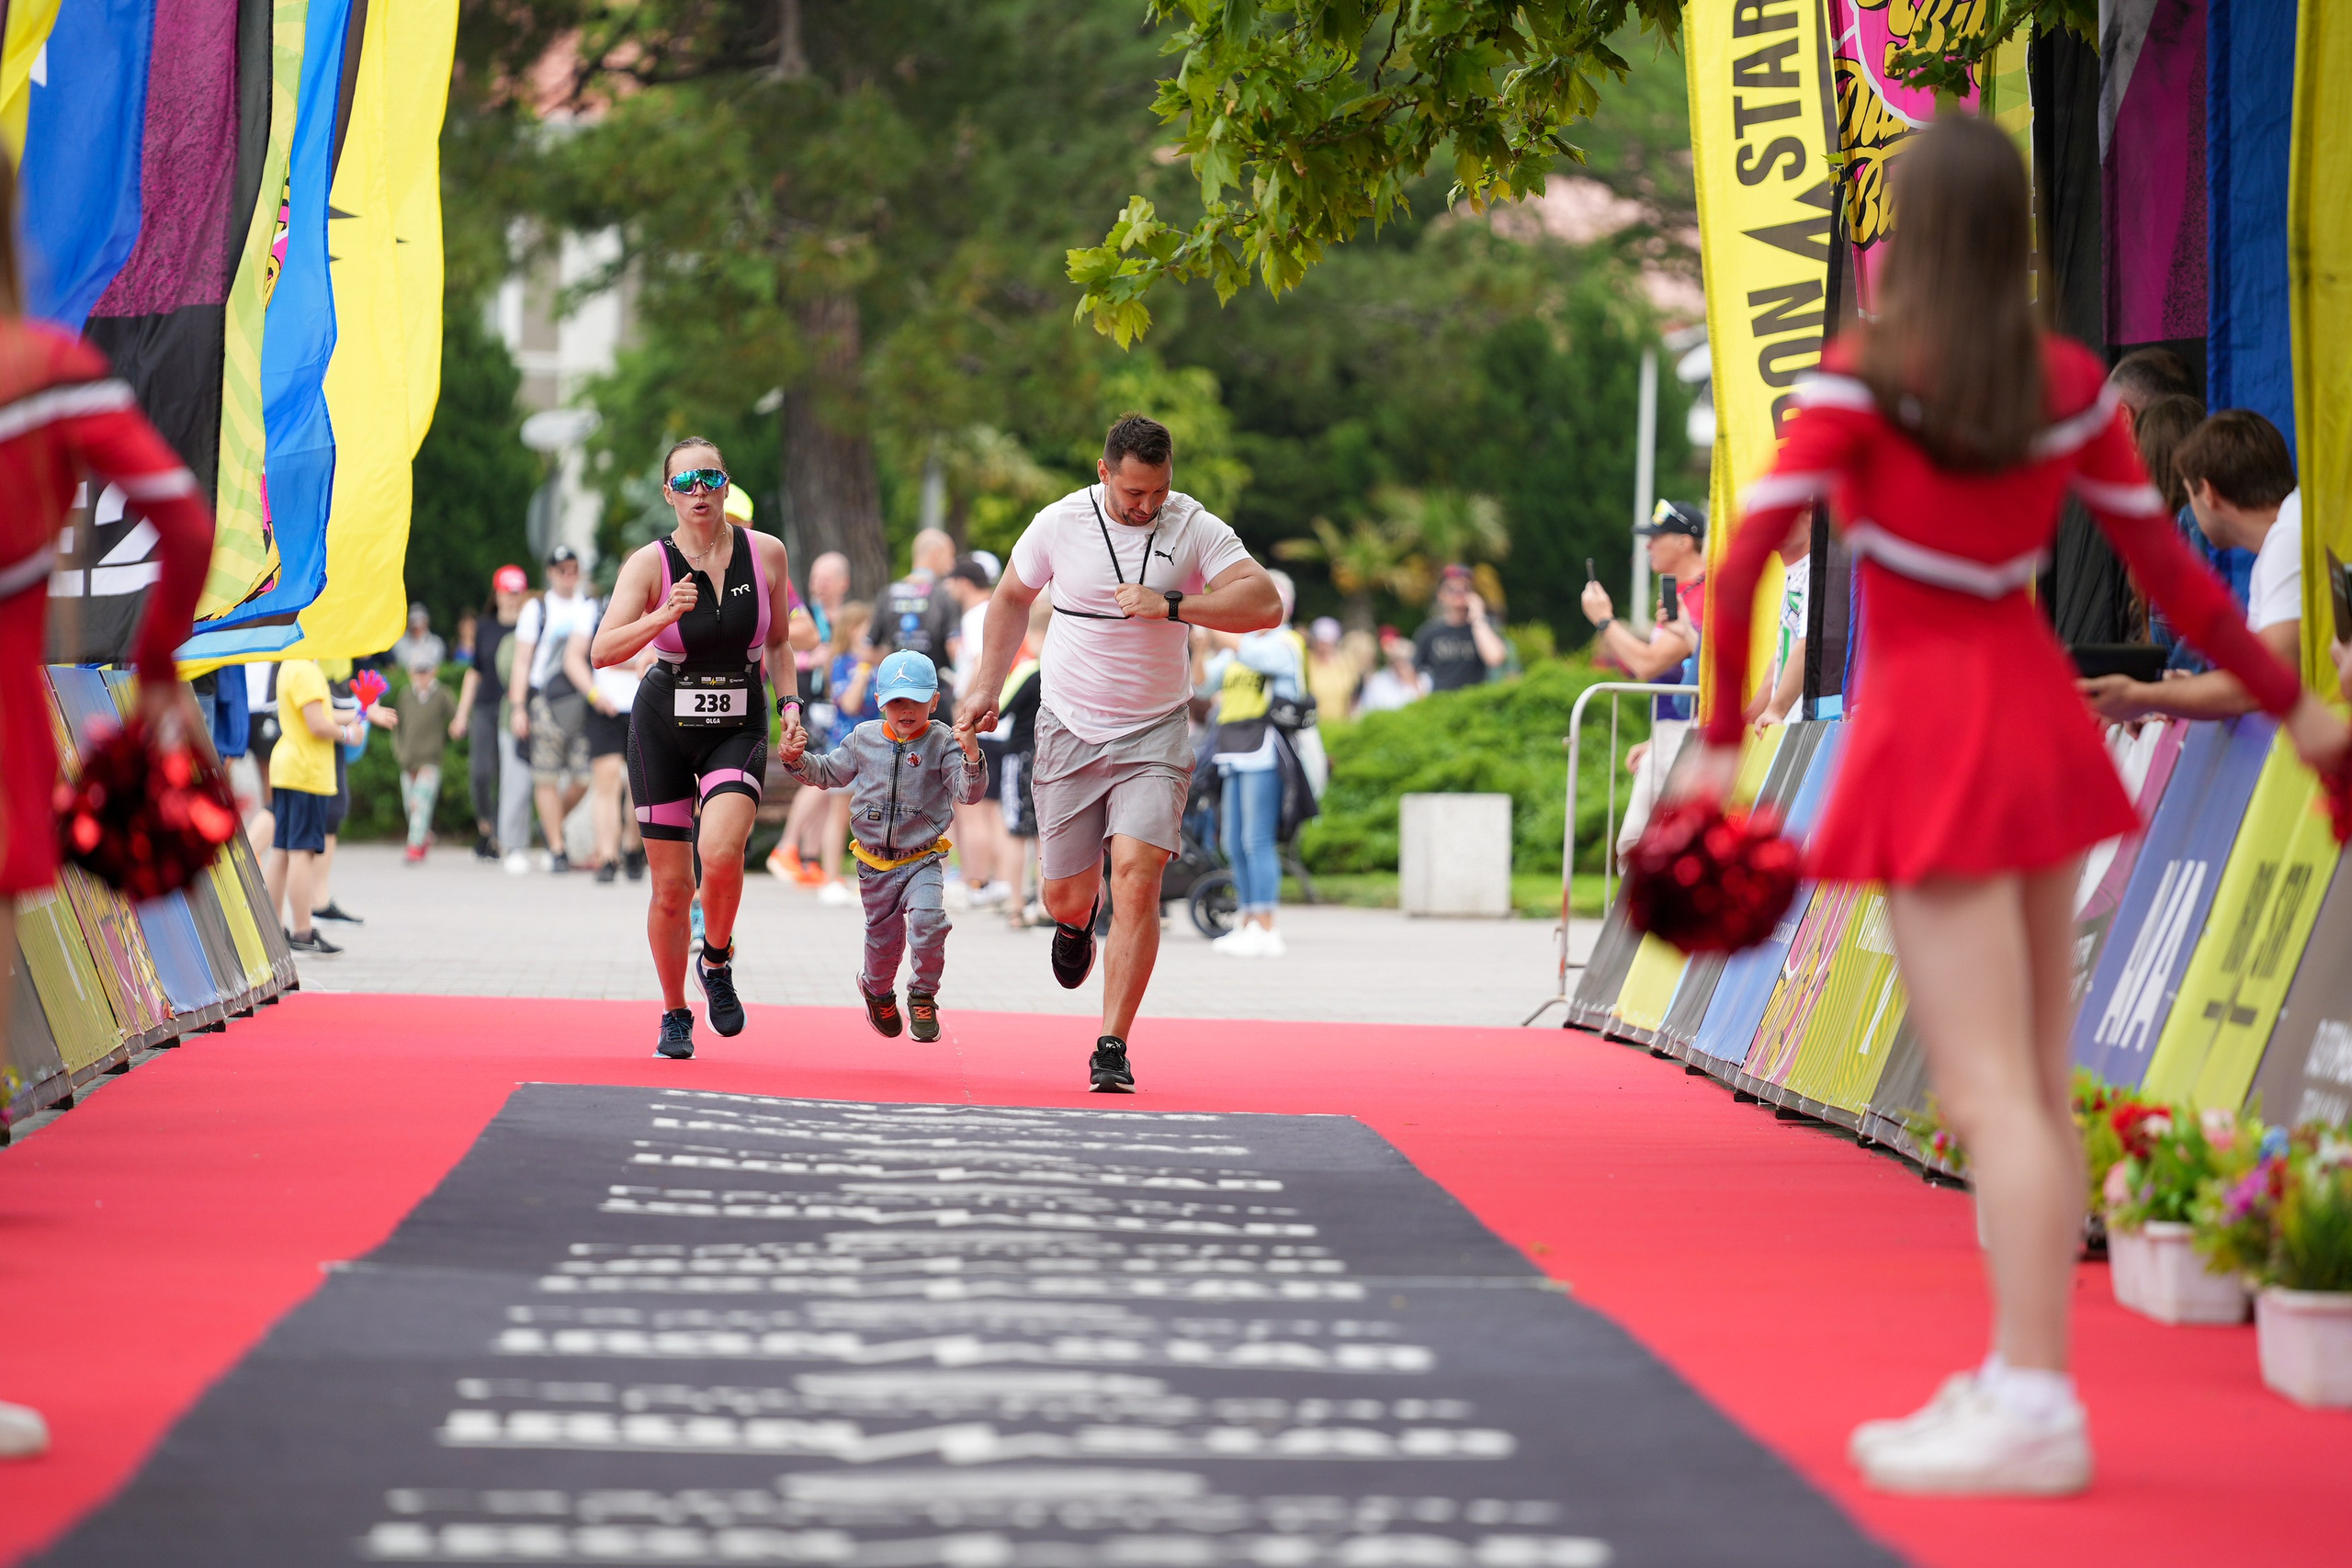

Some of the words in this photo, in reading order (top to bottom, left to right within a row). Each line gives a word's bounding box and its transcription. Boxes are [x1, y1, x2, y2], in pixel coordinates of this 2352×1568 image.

[1733, 0, 1806, 186] STAR
[730, 583, 751, 597] TYR
[695, 694, 731, 713] 238
